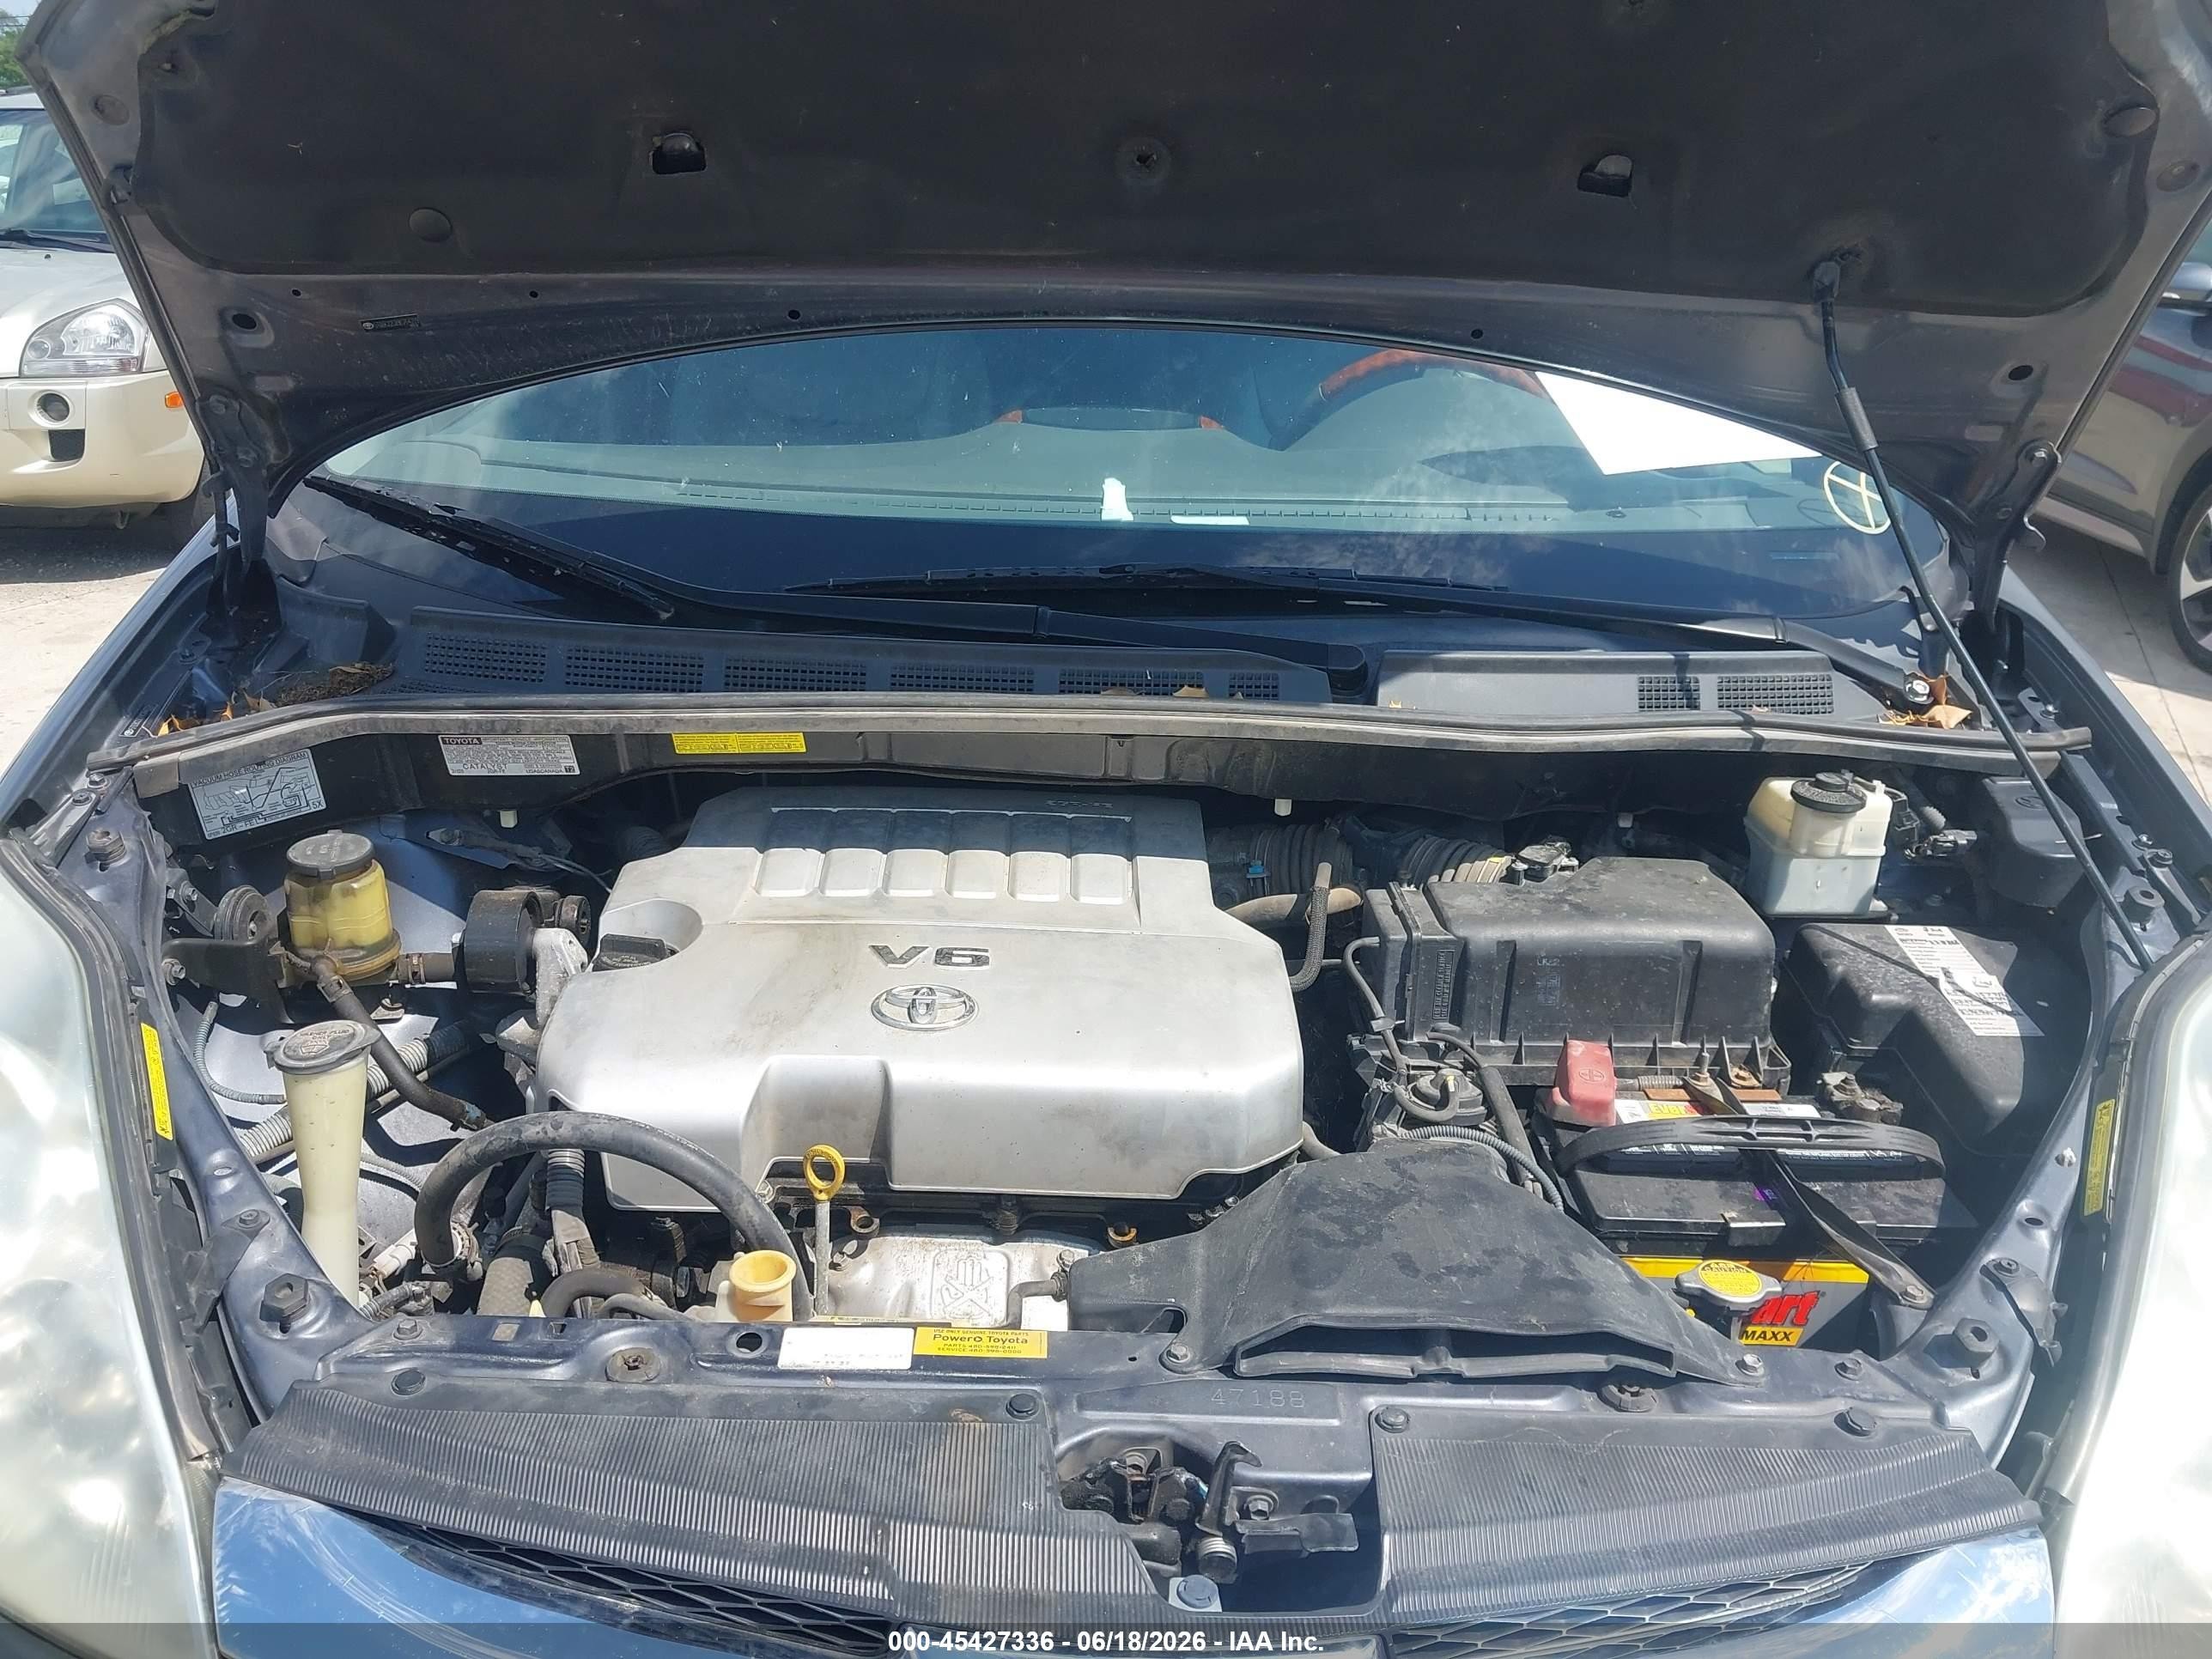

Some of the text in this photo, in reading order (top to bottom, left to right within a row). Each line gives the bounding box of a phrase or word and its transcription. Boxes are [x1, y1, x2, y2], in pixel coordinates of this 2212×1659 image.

[193, 774, 222, 787] VACUUM
[223, 769, 243, 779] HOSE
[244, 760, 275, 773] ROUTING
[274, 750, 307, 766] DIAGRAM
[311, 799, 324, 810] 5X
[868, 945, 990, 969] V6
[1752, 1291, 1820, 1325] art
[987, 1335, 1028, 1345] Toyota
[1740, 1329, 1794, 1342] MAXX
